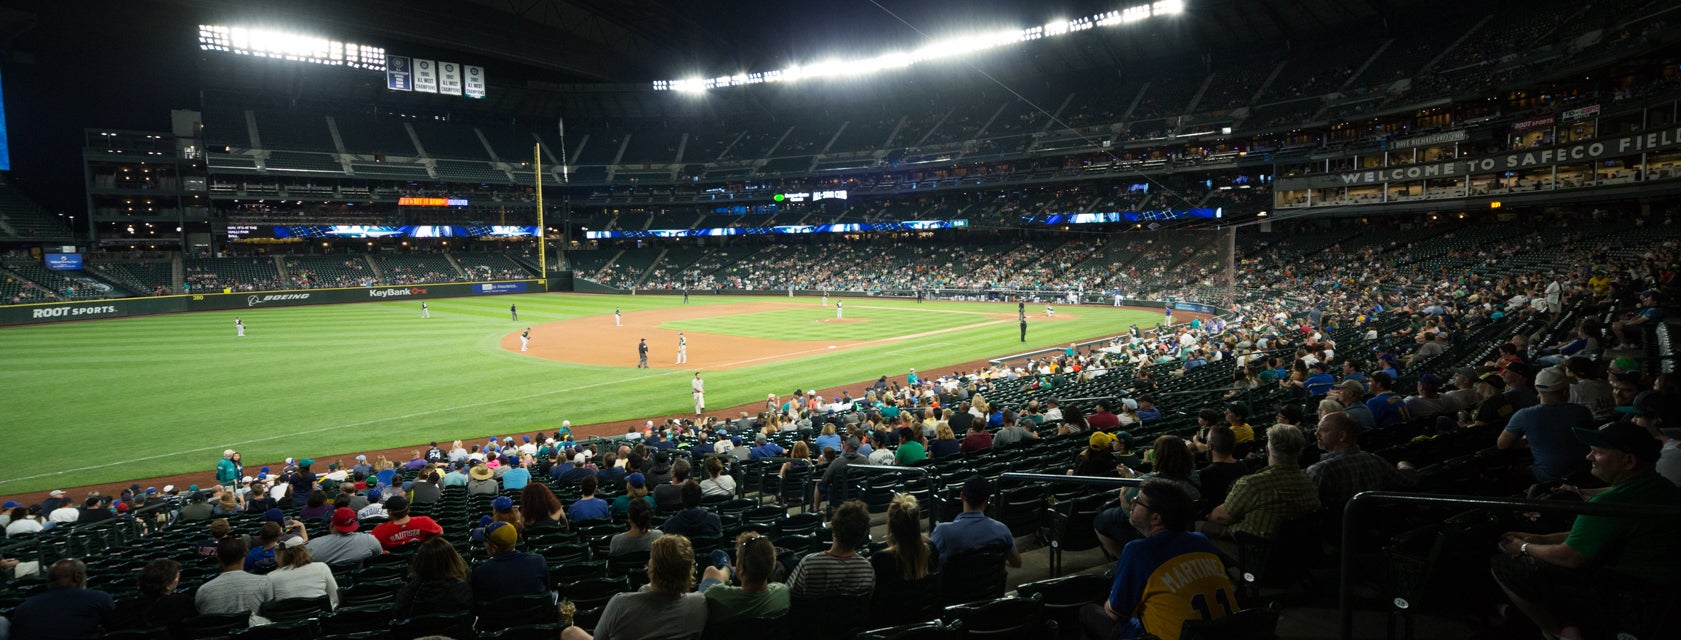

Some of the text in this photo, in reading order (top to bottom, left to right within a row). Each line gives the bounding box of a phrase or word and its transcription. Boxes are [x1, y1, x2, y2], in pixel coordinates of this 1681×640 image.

[1514, 118, 1554, 129] ROOT SPORTS
[1342, 162, 1455, 184] WELCOME
[1467, 159, 1495, 172] TO
[1507, 142, 1605, 167] SAFECO
[263, 293, 310, 302] BOEING
[369, 287, 411, 298] KeyBank
[32, 305, 114, 319] ROOT SPORTS
[389, 529, 420, 542] BAUTISTA
[1191, 588, 1233, 624] 11
